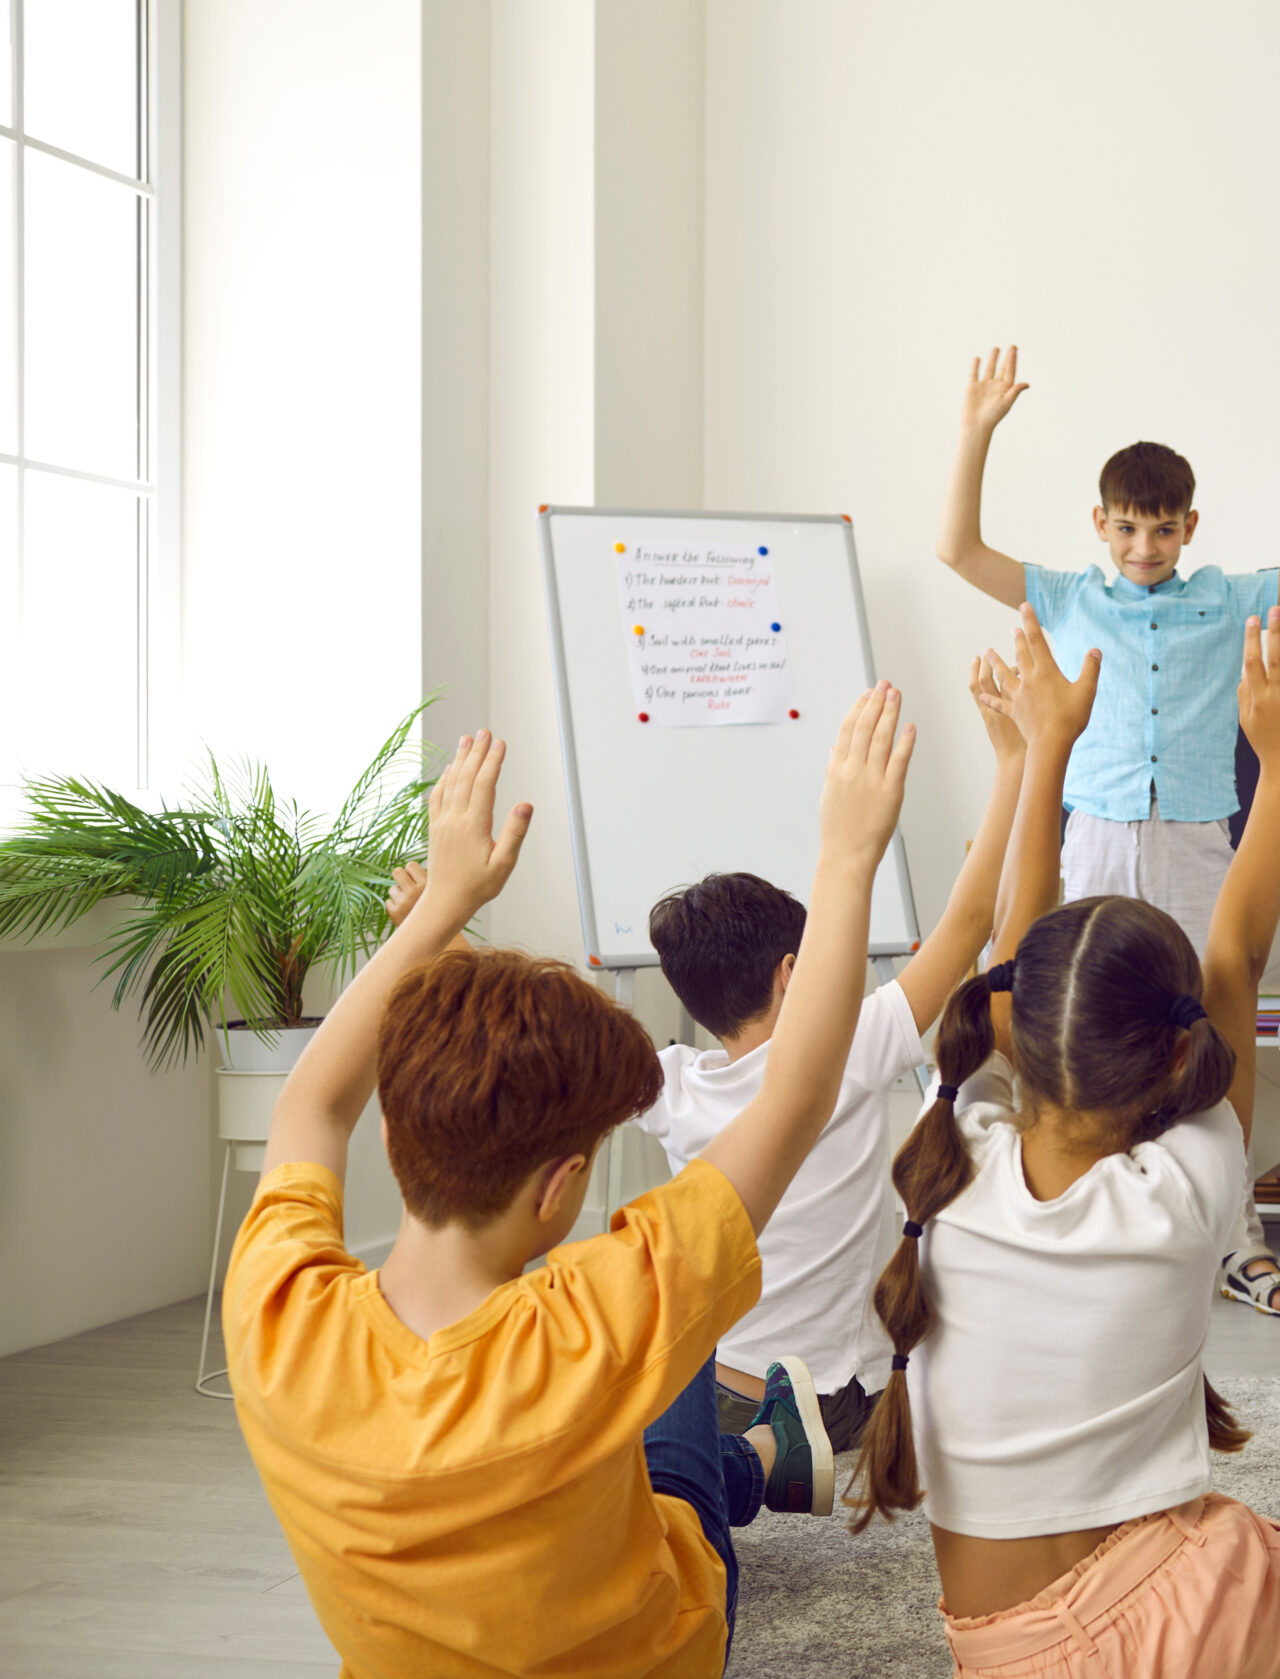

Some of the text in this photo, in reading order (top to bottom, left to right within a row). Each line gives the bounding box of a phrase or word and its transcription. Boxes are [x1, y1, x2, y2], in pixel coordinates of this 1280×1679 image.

[634, 574, 656, 586] The
[636, 597, 654, 609] The
[671, 635, 696, 647] with
[700, 634, 743, 647] smallest
[650, 663, 667, 675] One
[709, 661, 730, 672] that
[733, 660, 756, 672] lives
[656, 685, 676, 698] One
